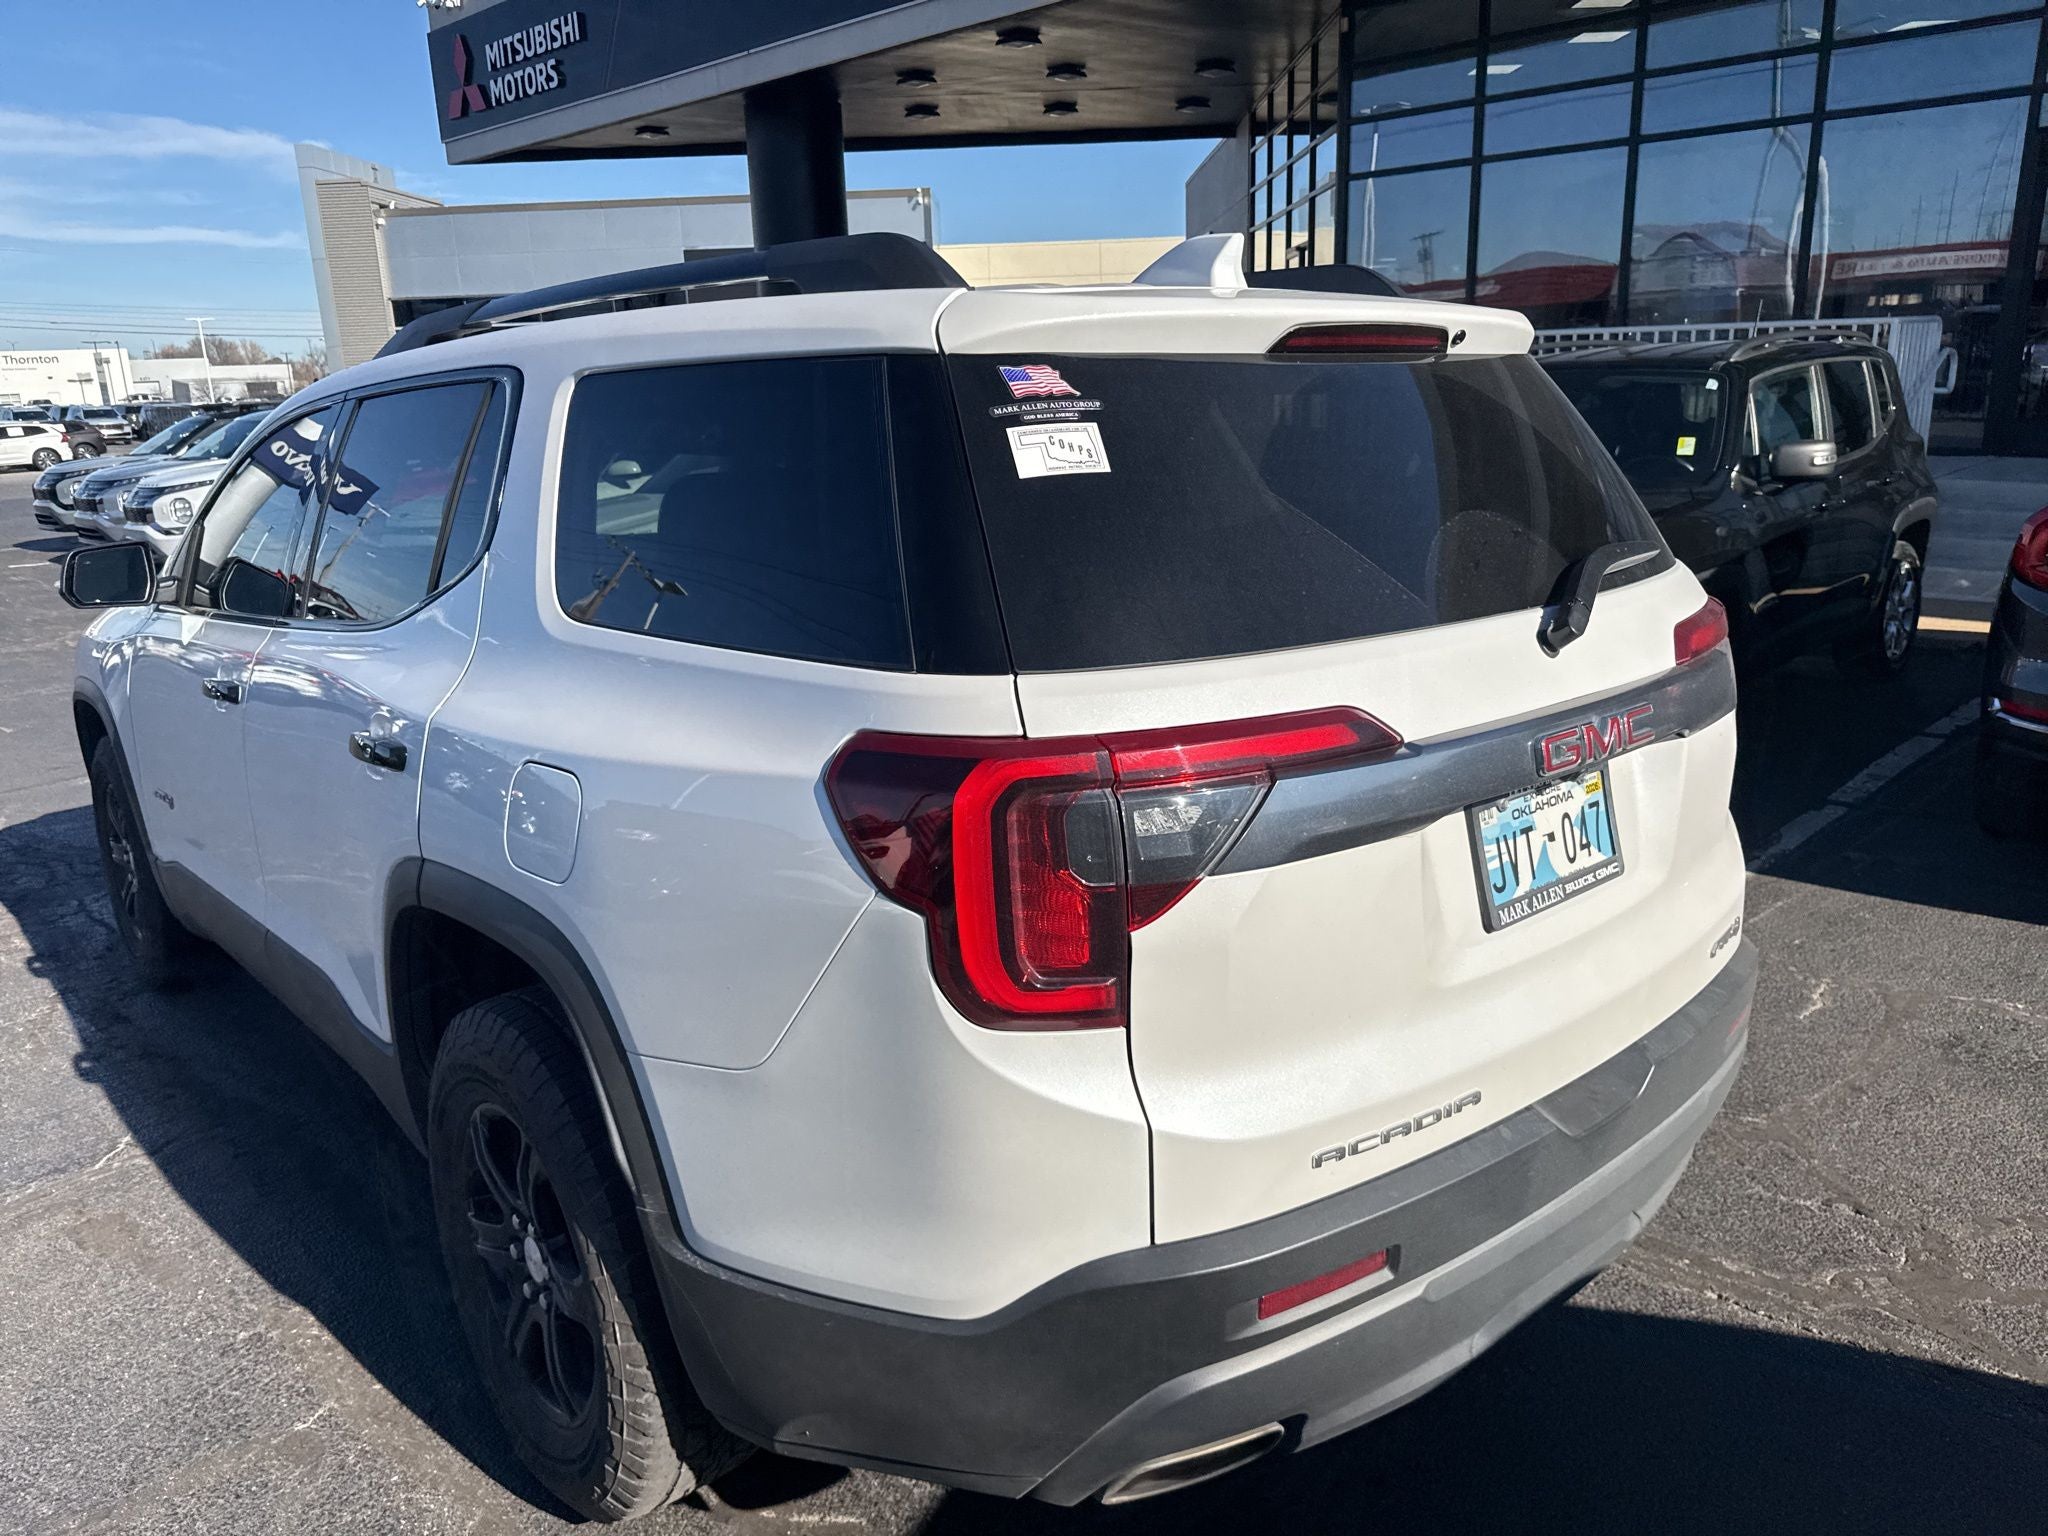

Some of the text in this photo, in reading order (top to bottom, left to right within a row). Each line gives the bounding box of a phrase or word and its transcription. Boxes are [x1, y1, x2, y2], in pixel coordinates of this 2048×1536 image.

[485, 11, 580, 72] MITSUBISHI
[490, 58, 559, 107] MOTORS
[2, 354, 59, 365] Thornton
[993, 405, 1020, 415] MARK
[1021, 402, 1048, 411] ALLEN
[1049, 401, 1073, 409] AUTO
[1541, 703, 1655, 776] GMC
[1511, 790, 1574, 821] OKLAHOMA
[1493, 825, 1537, 894] JVT
[1561, 800, 1602, 864] 047
[1498, 901, 1532, 926] MARK
[1532, 883, 1565, 915] ALLEN
[1565, 873, 1596, 895] BUICK
[1595, 862, 1620, 880] GMC
[1311, 1088, 1482, 1170] ACADIA
